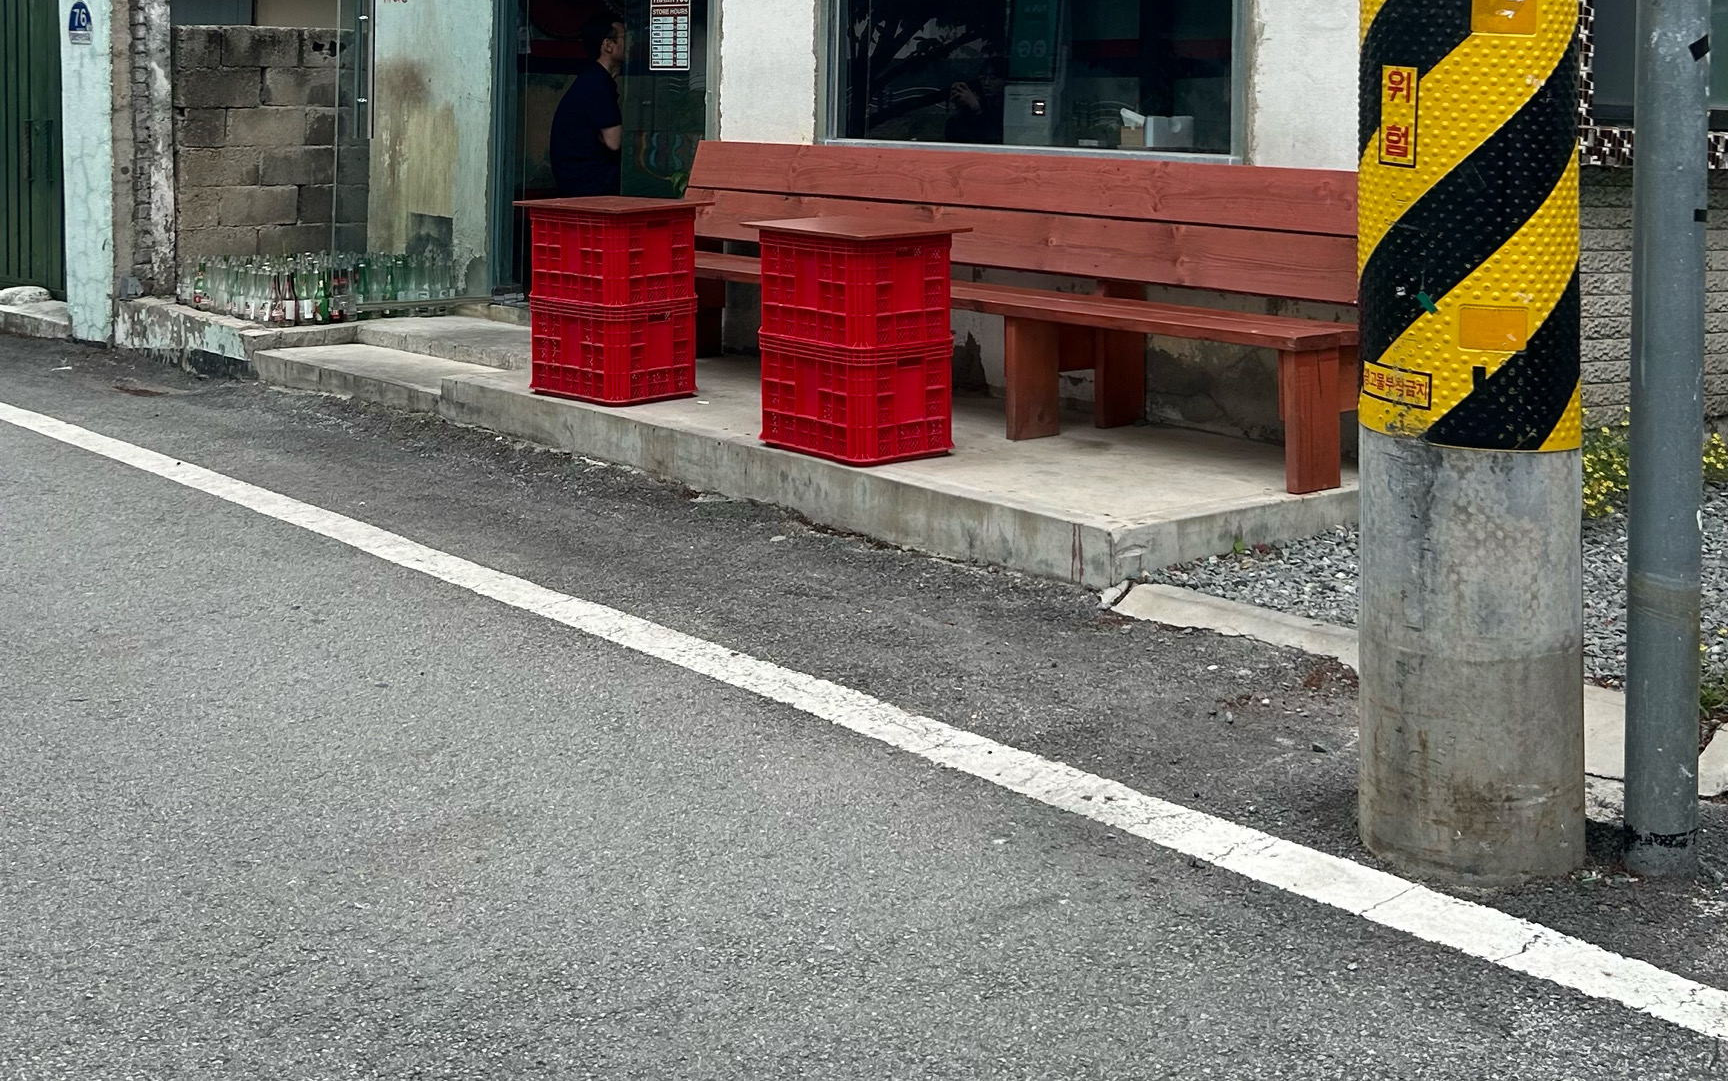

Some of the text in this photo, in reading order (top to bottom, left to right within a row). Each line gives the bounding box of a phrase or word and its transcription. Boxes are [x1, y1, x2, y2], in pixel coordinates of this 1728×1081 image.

[72, 8, 87, 27] 76
[652, 7, 688, 16] STORE HOURS
[1385, 69, 1412, 158] 위험
